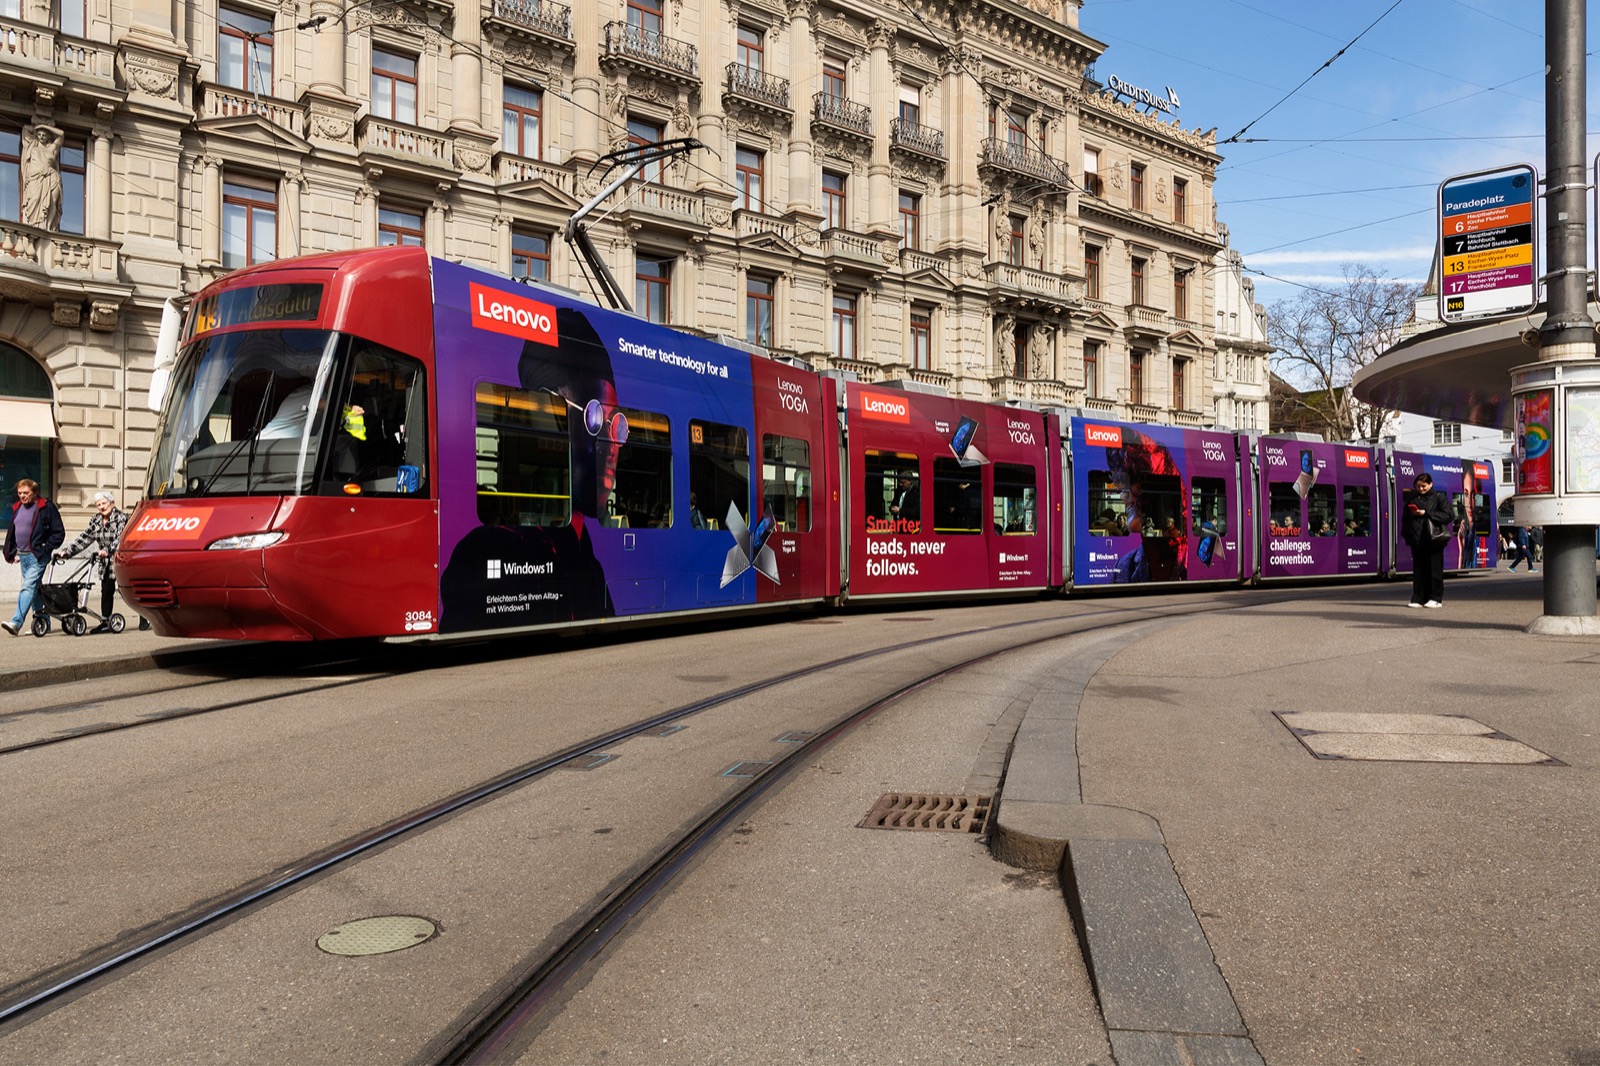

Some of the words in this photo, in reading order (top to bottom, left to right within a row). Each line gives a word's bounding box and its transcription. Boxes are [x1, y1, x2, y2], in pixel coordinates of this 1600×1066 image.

[1446, 195, 1505, 211] Paradeplatz
[1455, 221, 1464, 233] 6
[1455, 241, 1464, 252] 7
[1449, 261, 1464, 272] 13
[1450, 281, 1464, 293] 17
[1448, 301, 1463, 310] N16
[478, 293, 551, 333] Lenovo
[618, 337, 657, 359] Smarter
[658, 349, 706, 374] technology
[706, 361, 718, 376] for
[719, 365, 729, 379] all
[777, 376, 803, 394] Lenovo
[779, 392, 809, 414] YOGA
[864, 397, 906, 416] Lenovo
[1006, 418, 1030, 430] Lenovo
[692, 428, 701, 441] 13
[1008, 430, 1035, 445] YOGA
[1087, 428, 1119, 442] Lenovo
[1202, 440, 1222, 450] Lenovo
[1265, 446, 1283, 455] Lenovo
[1203, 450, 1226, 461] YOGA
[1267, 455, 1287, 466] YOGA
[1346, 453, 1367, 464] Lenovo
[1400, 466, 1415, 476] YOGA
[1474, 467, 1488, 475] Lenovo
[136, 515, 200, 531] Lenovo
[867, 515, 920, 533] Smarter
[1270, 526, 1301, 536] Smarter
[866, 537, 907, 558] leads,
[910, 541, 946, 555] never
[1270, 539, 1311, 553] challenges
[1270, 553, 1314, 565] convention.
[503, 561, 545, 575] Windows
[545, 561, 553, 574] 11
[866, 558, 918, 576] follows.
[497, 604, 524, 613] Windows
[405, 610, 432, 621] 3084
